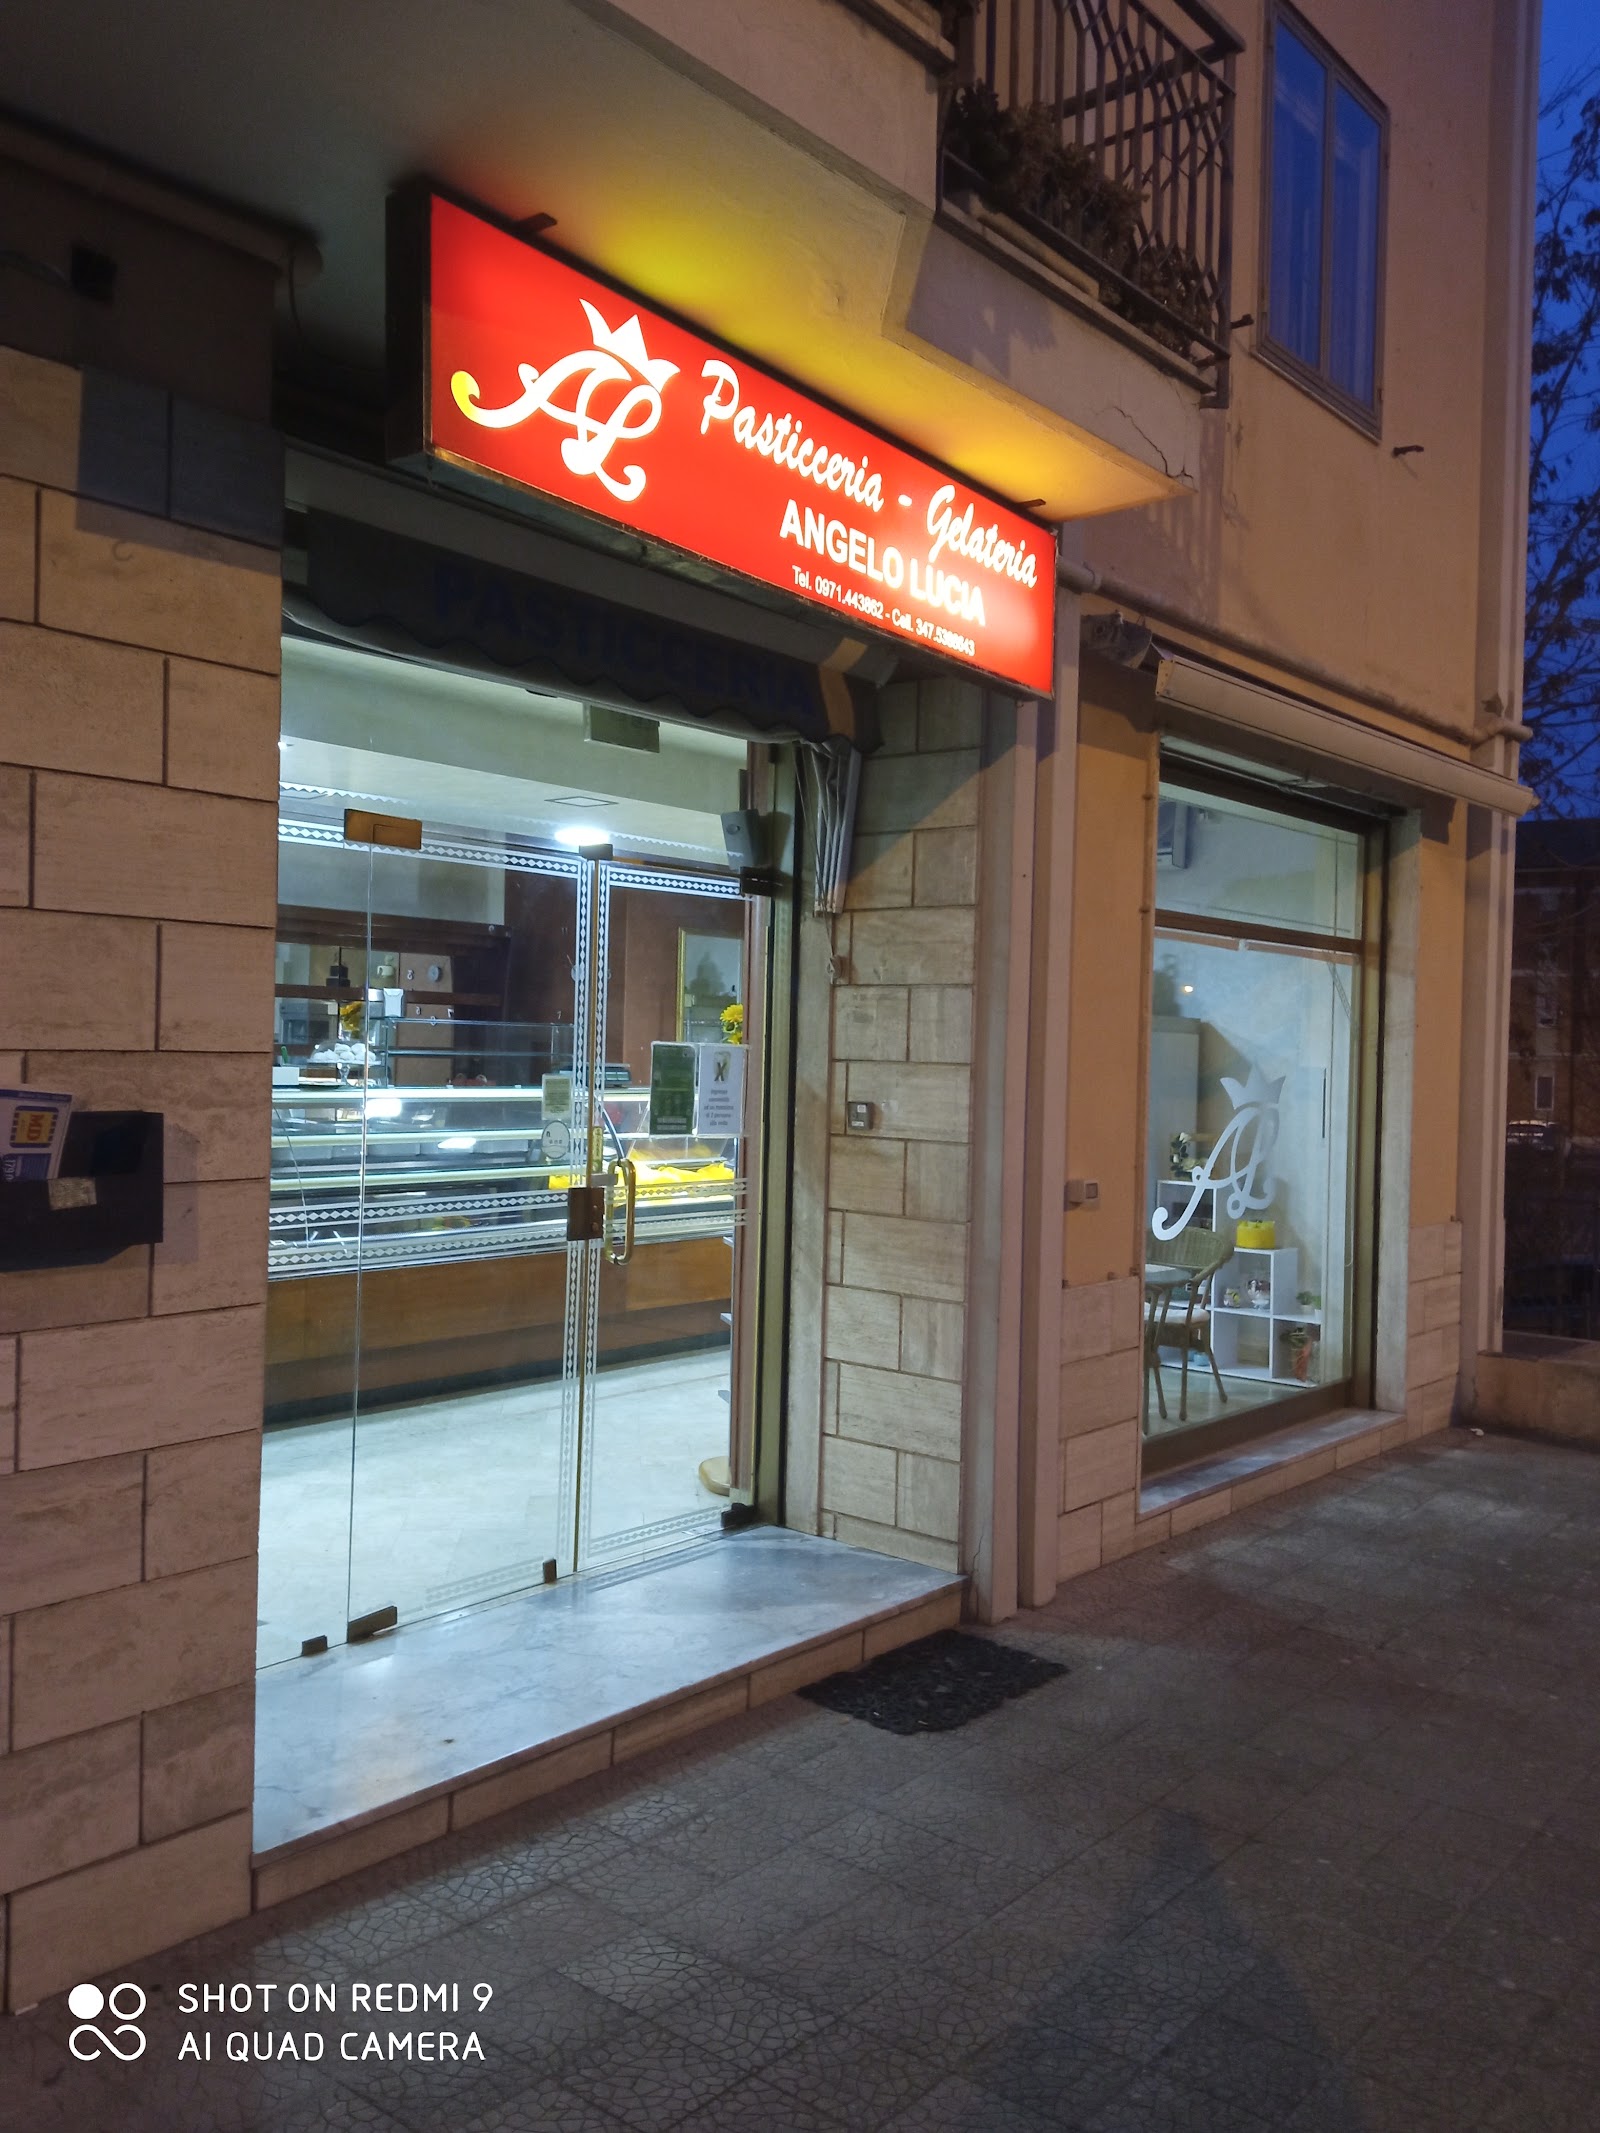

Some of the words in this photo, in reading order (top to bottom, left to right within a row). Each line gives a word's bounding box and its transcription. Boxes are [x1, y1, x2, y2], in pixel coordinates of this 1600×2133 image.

[701, 359, 885, 513] Pasticceria
[897, 494, 913, 508] -
[926, 484, 1038, 589] Gelateria
[779, 498, 904, 589] ANGELO
[909, 557, 986, 627] LUCIA
[792, 564, 813, 591] Tel.
[432, 560, 816, 717] PASTICCERIA
[27, 1113, 45, 1140] MD
